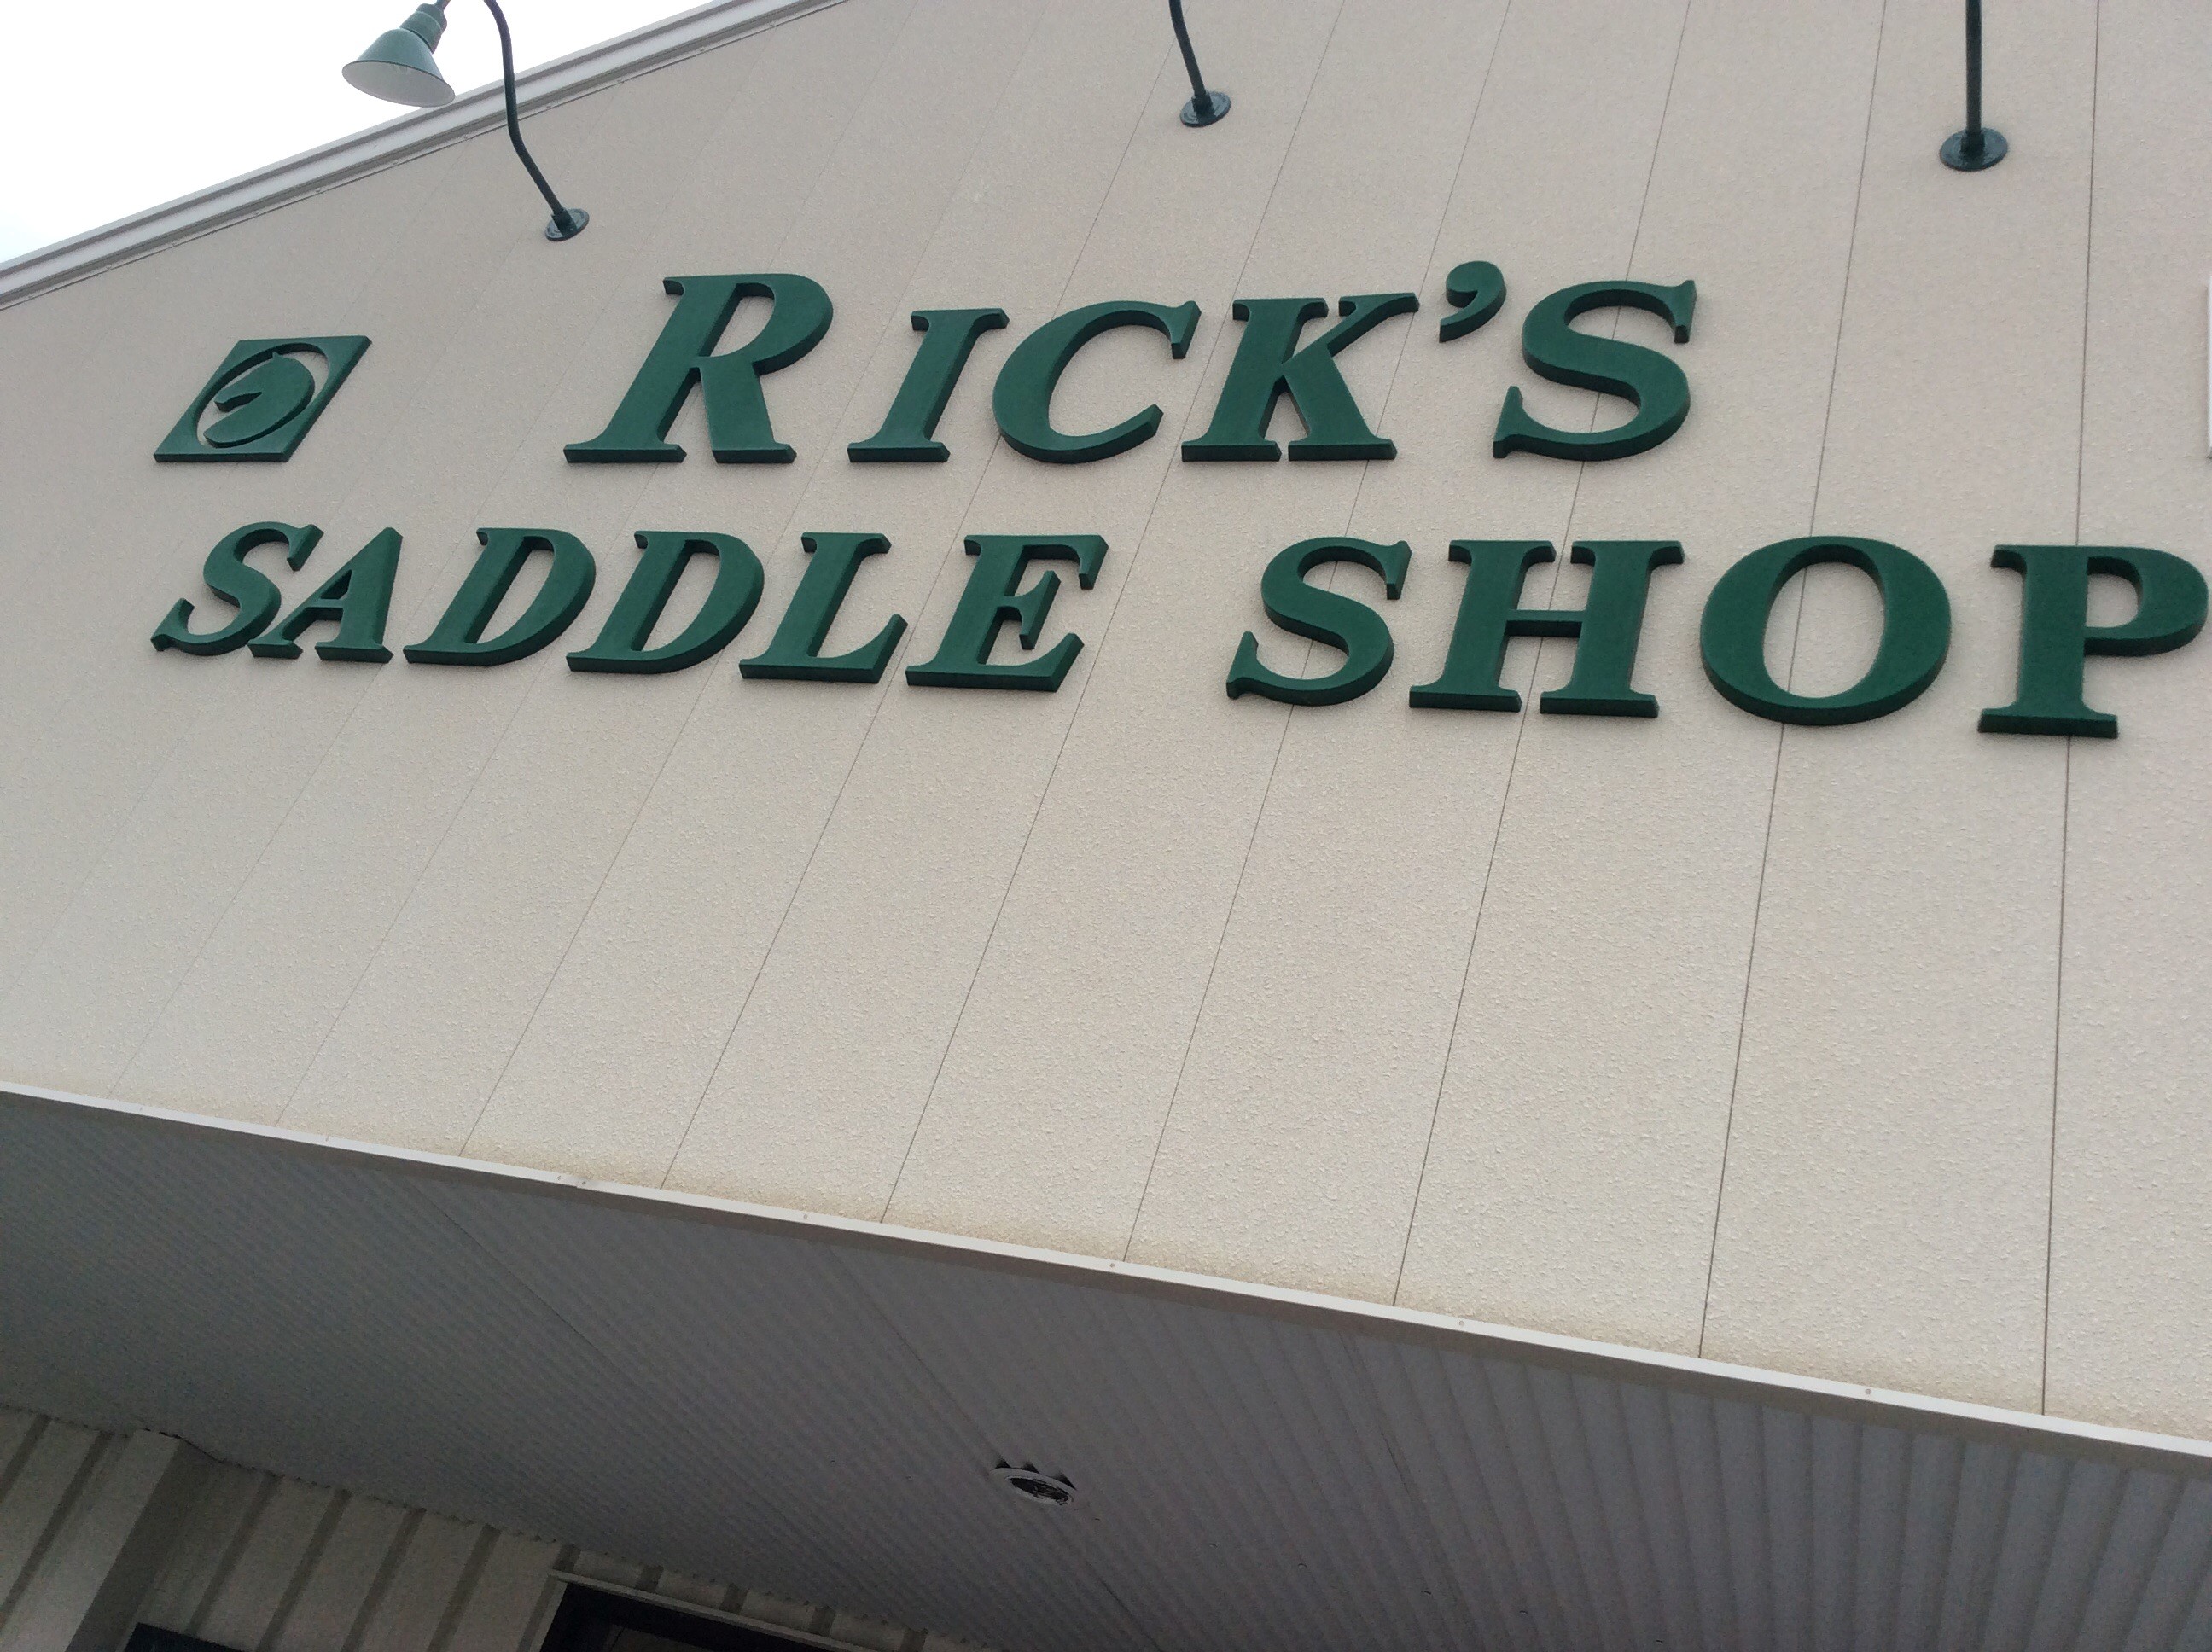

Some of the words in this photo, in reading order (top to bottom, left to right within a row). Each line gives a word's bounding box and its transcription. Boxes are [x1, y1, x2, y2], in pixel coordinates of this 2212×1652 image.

[565, 261, 1697, 464] RICK'S
[151, 521, 1107, 694] SADDLE
[1226, 536, 2209, 739] SHOP
